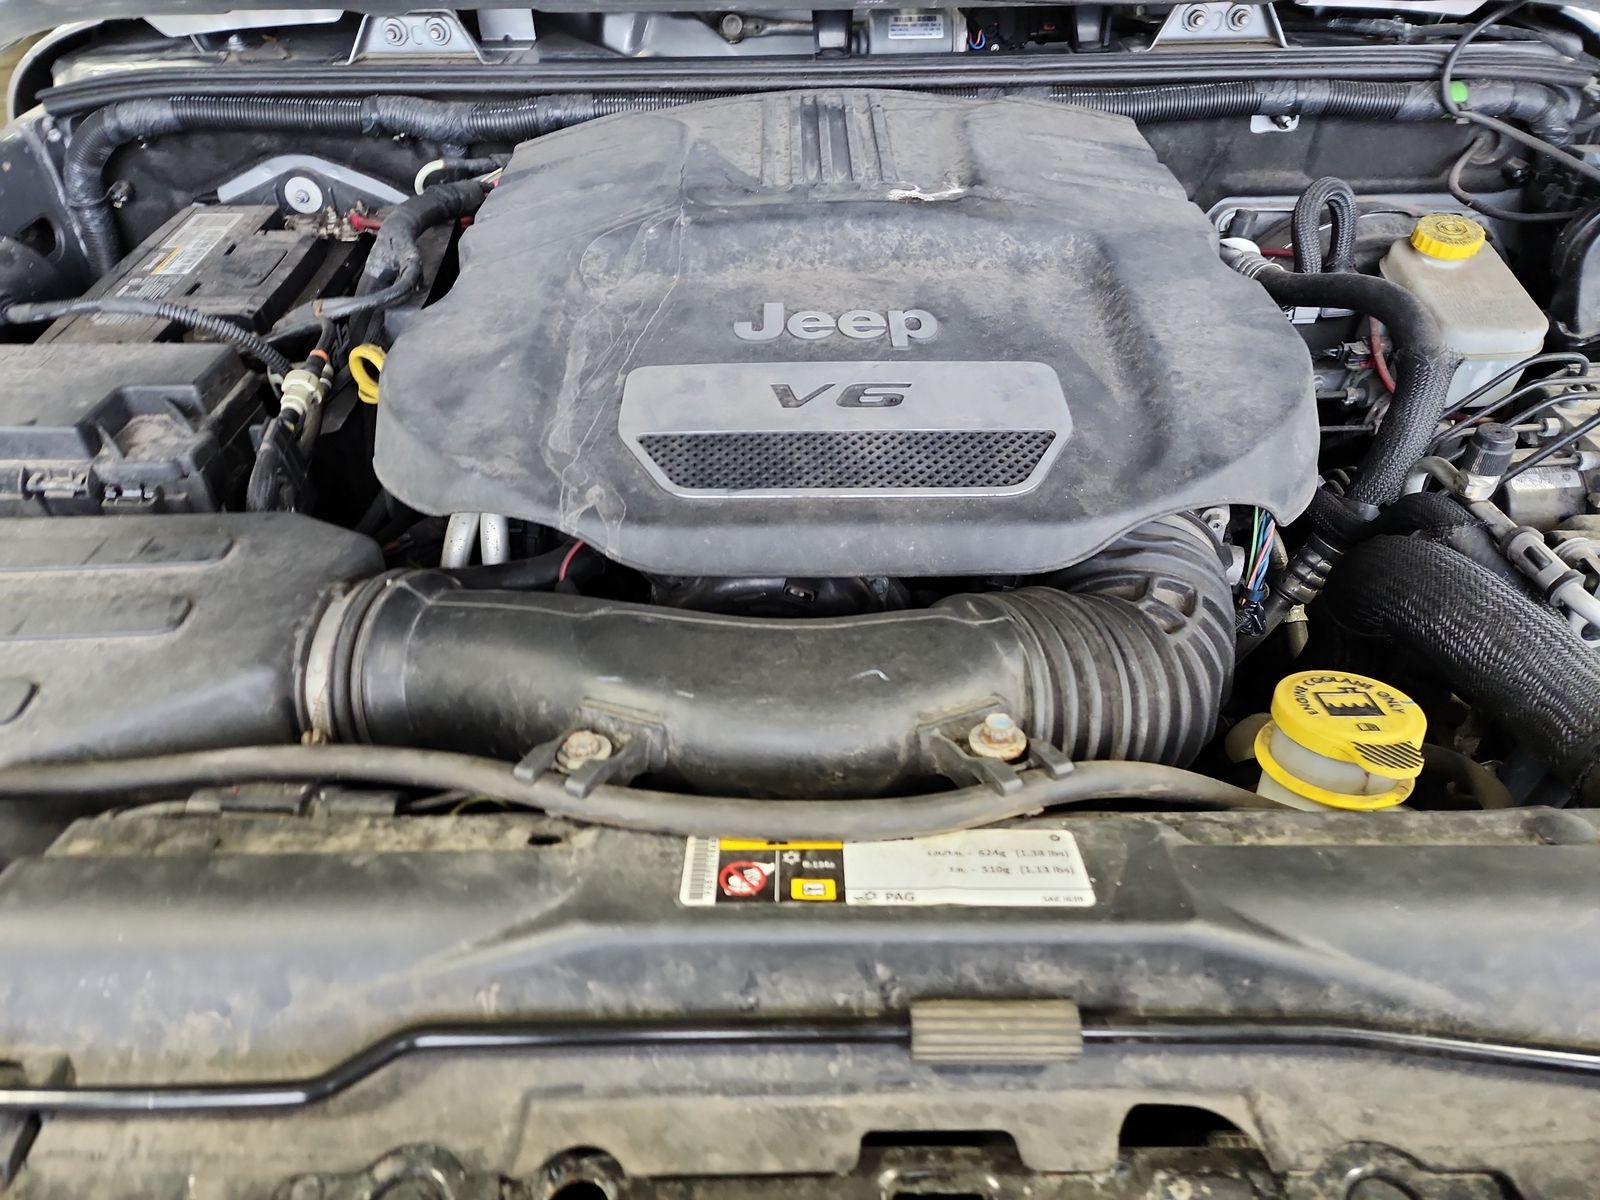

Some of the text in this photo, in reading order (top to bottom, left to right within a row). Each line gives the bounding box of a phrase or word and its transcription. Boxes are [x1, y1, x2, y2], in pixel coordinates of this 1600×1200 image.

[733, 302, 938, 347] Jeep
[770, 383, 912, 408] V6
[1303, 676, 1375, 690] COOLANT
[1376, 691, 1405, 714] ONLY
[885, 892, 915, 901] PAG
